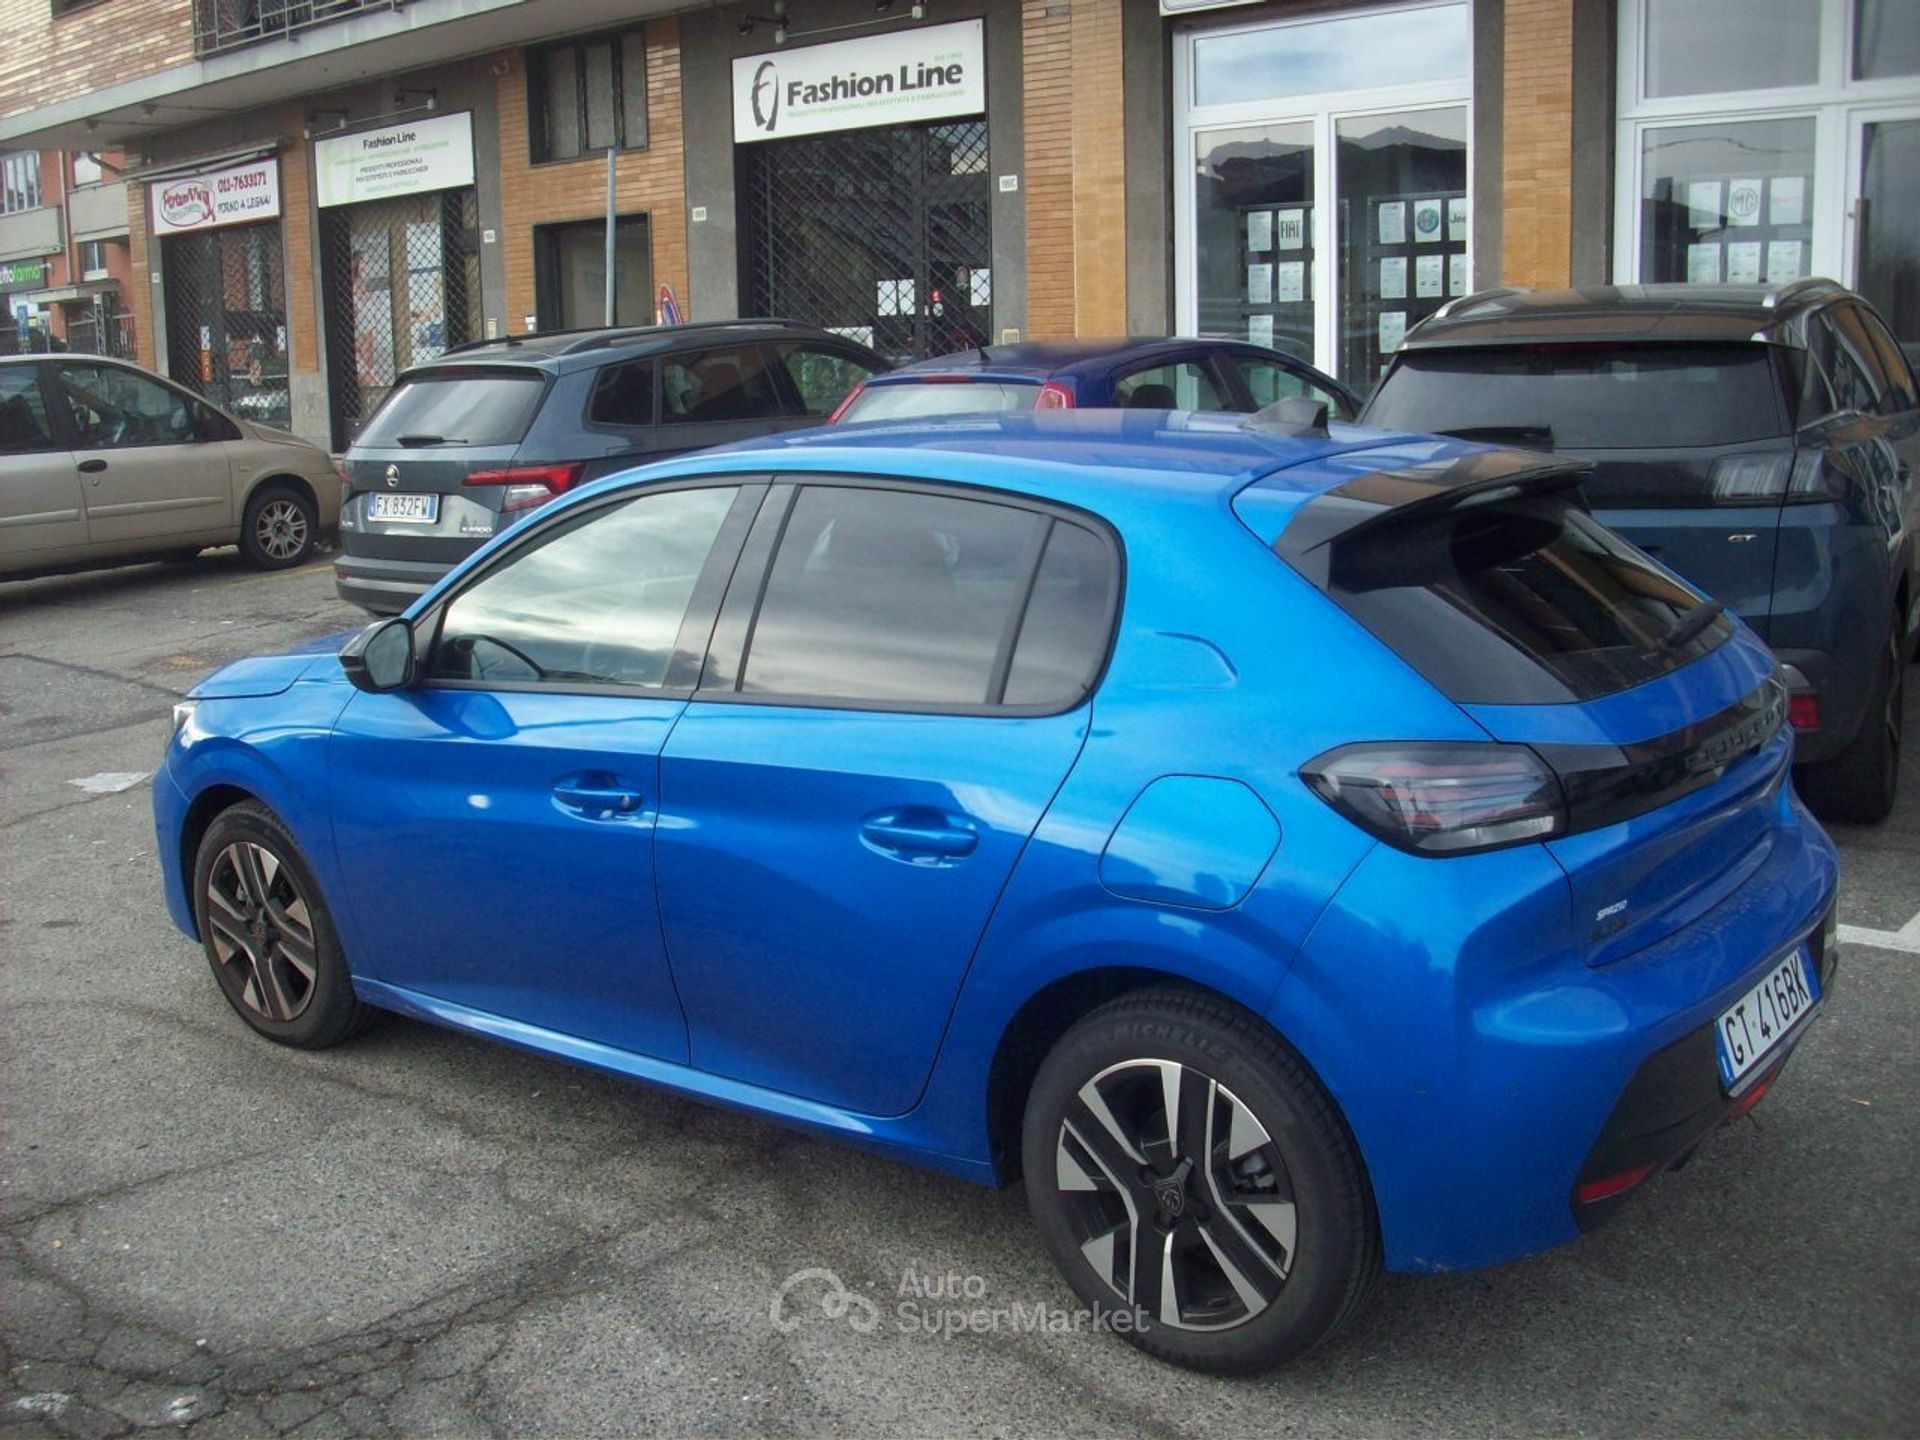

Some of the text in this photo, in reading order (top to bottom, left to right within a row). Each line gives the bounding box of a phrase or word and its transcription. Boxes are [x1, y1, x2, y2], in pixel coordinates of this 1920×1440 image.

[787, 72, 894, 106] Fashion
[900, 62, 963, 91] Line
[363, 132, 416, 151] Fashion Line
[1451, 213, 1466, 224] Jee
[1280, 220, 1300, 240] FIAT
[376, 496, 390, 517] FX
[1725, 954, 1809, 1067] GT 416BK
